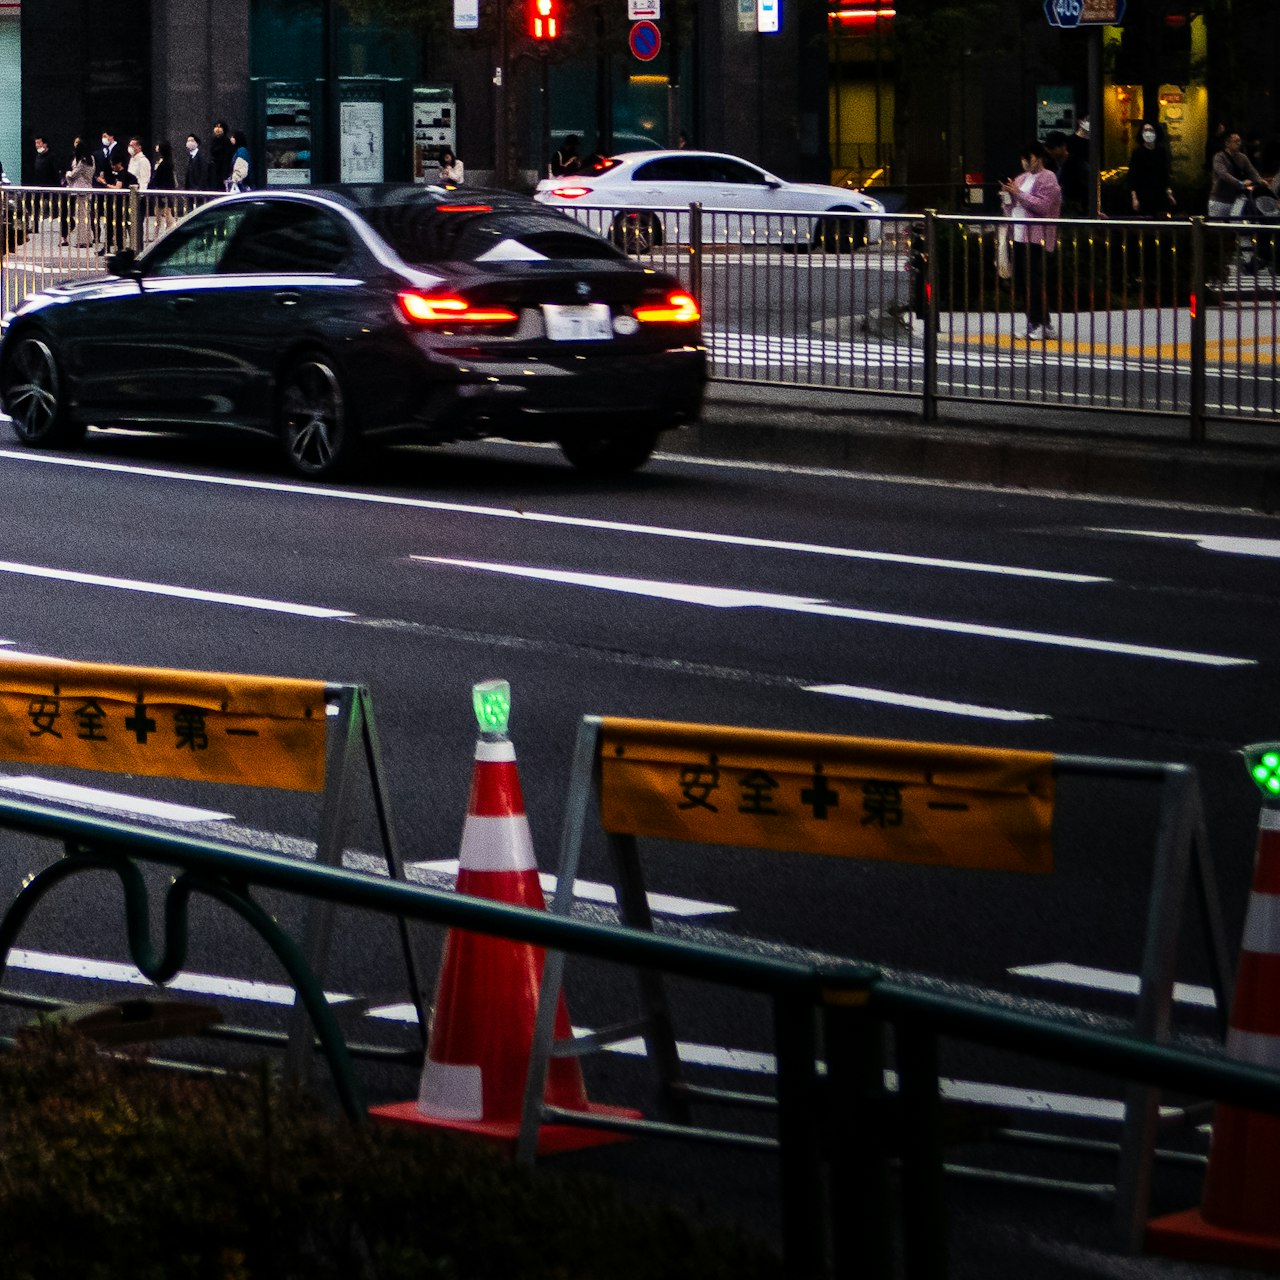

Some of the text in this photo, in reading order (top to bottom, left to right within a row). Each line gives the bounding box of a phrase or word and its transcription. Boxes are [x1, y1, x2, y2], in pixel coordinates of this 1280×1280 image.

[27, 697, 259, 751] 安全 第一
[678, 766, 969, 827] 安全 第一
